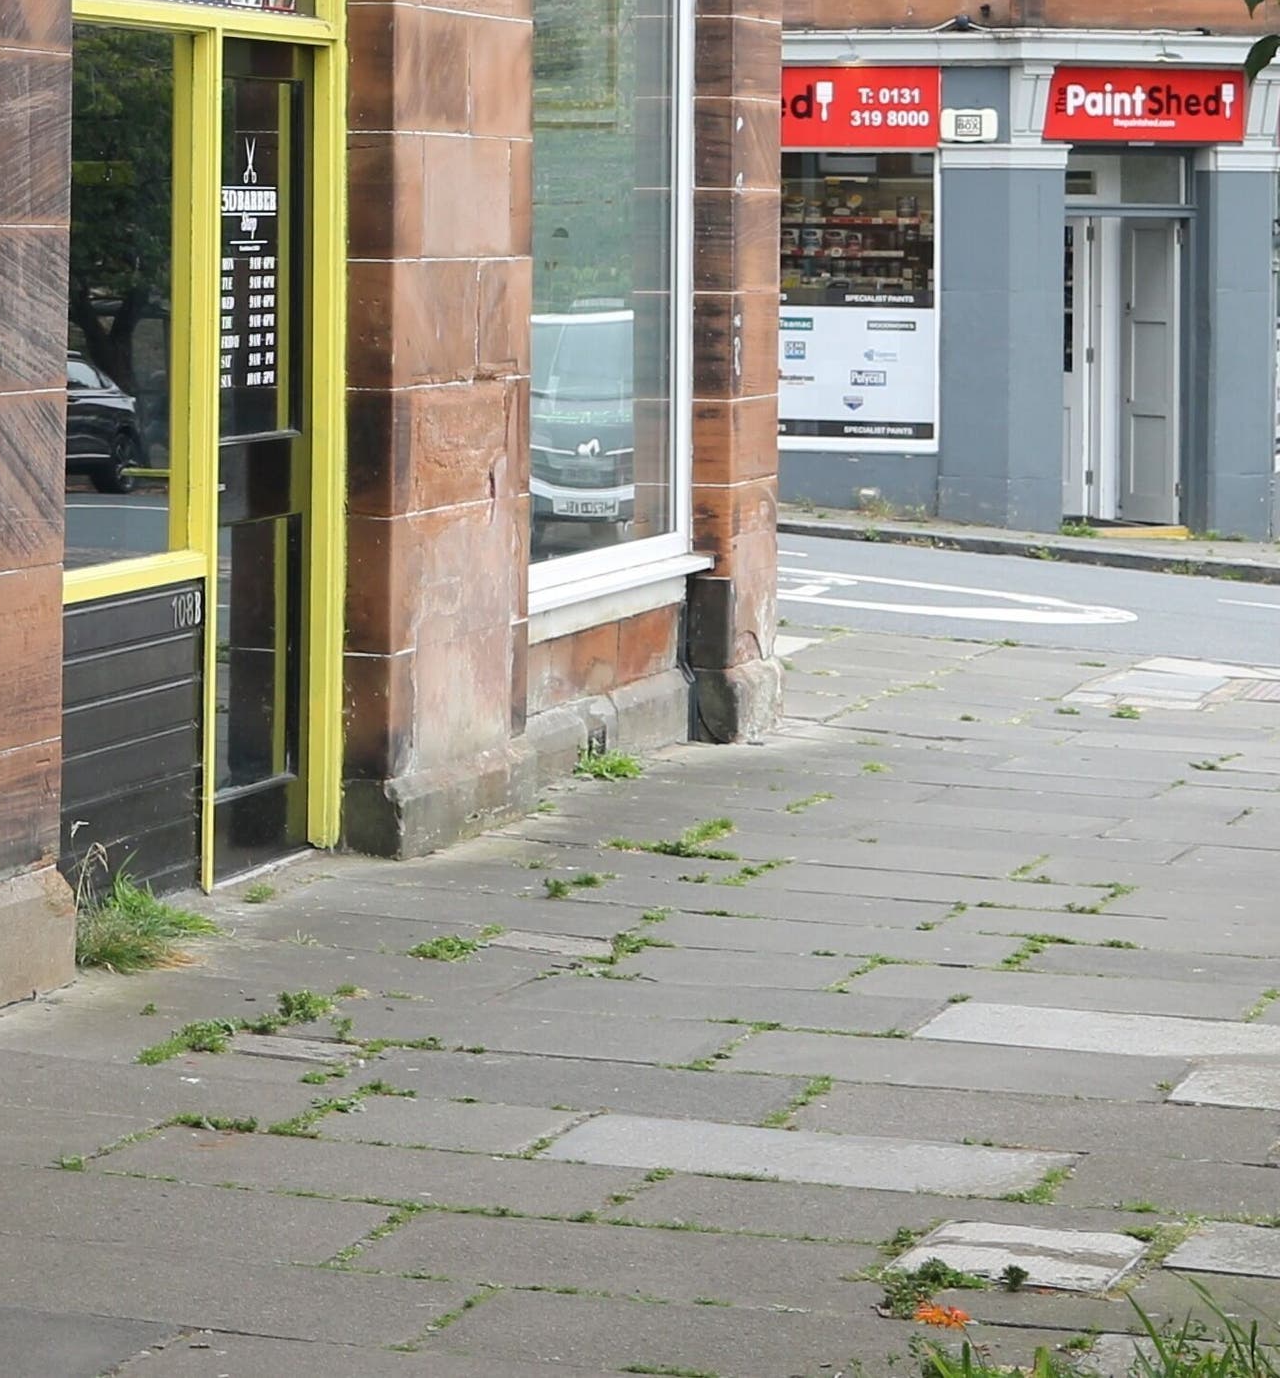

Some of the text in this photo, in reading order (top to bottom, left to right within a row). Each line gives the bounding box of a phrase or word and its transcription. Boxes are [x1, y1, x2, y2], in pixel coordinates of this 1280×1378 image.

[858, 88, 921, 104] T: 0131
[850, 111, 929, 126] 319 8000
[845, 294, 915, 303] SPECIALIST PAINTS
[844, 426, 913, 435] SPECIALIST PAINTS
[172, 591, 201, 628] 108B
